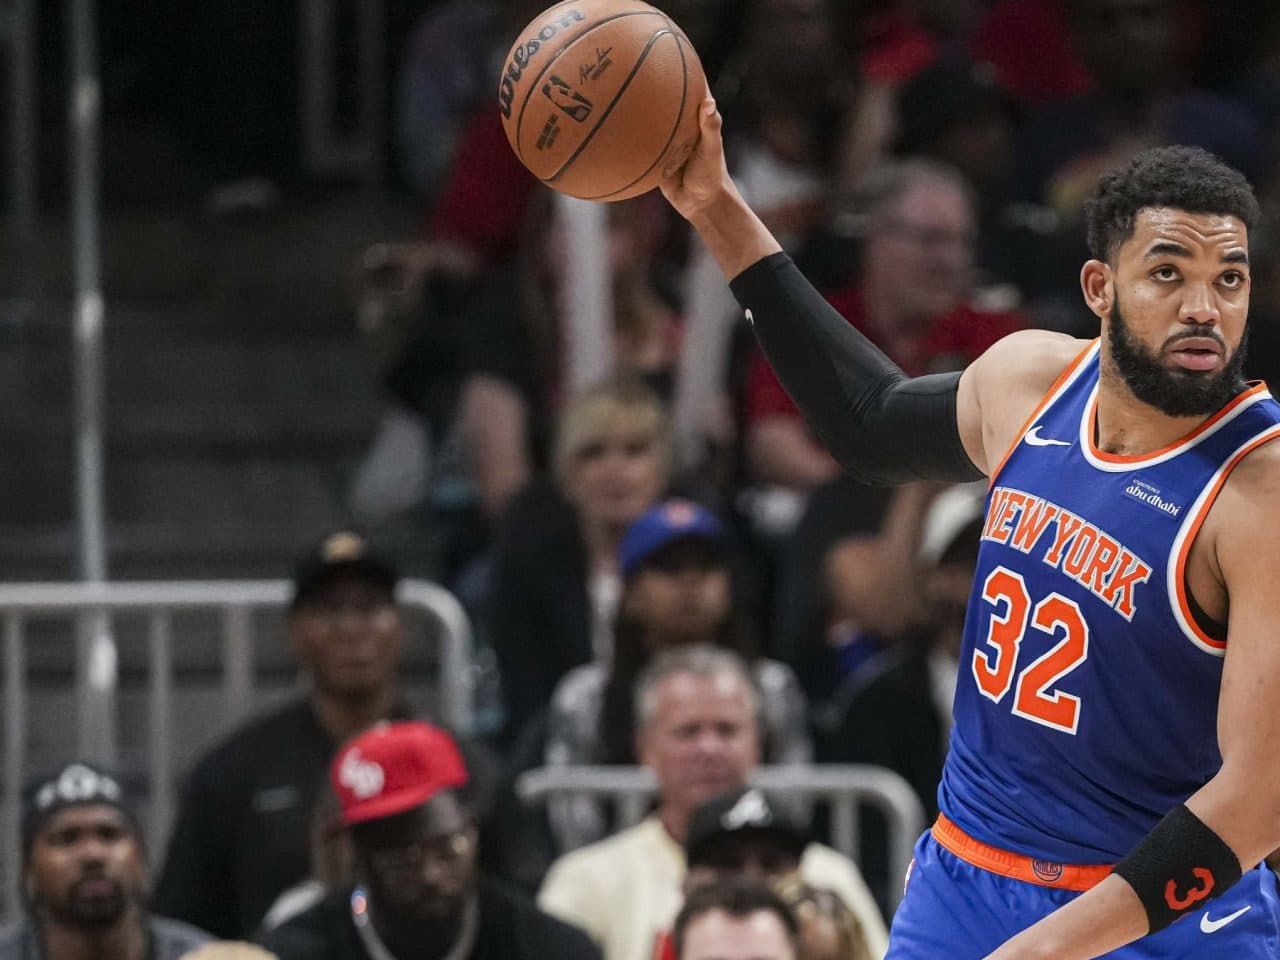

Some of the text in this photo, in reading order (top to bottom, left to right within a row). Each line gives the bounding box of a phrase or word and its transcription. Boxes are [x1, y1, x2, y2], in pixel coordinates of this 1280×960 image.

[980, 487, 1153, 623] NEW YORK
[1125, 485, 1182, 516] abu dhabi
[972, 565, 1089, 735] 32
